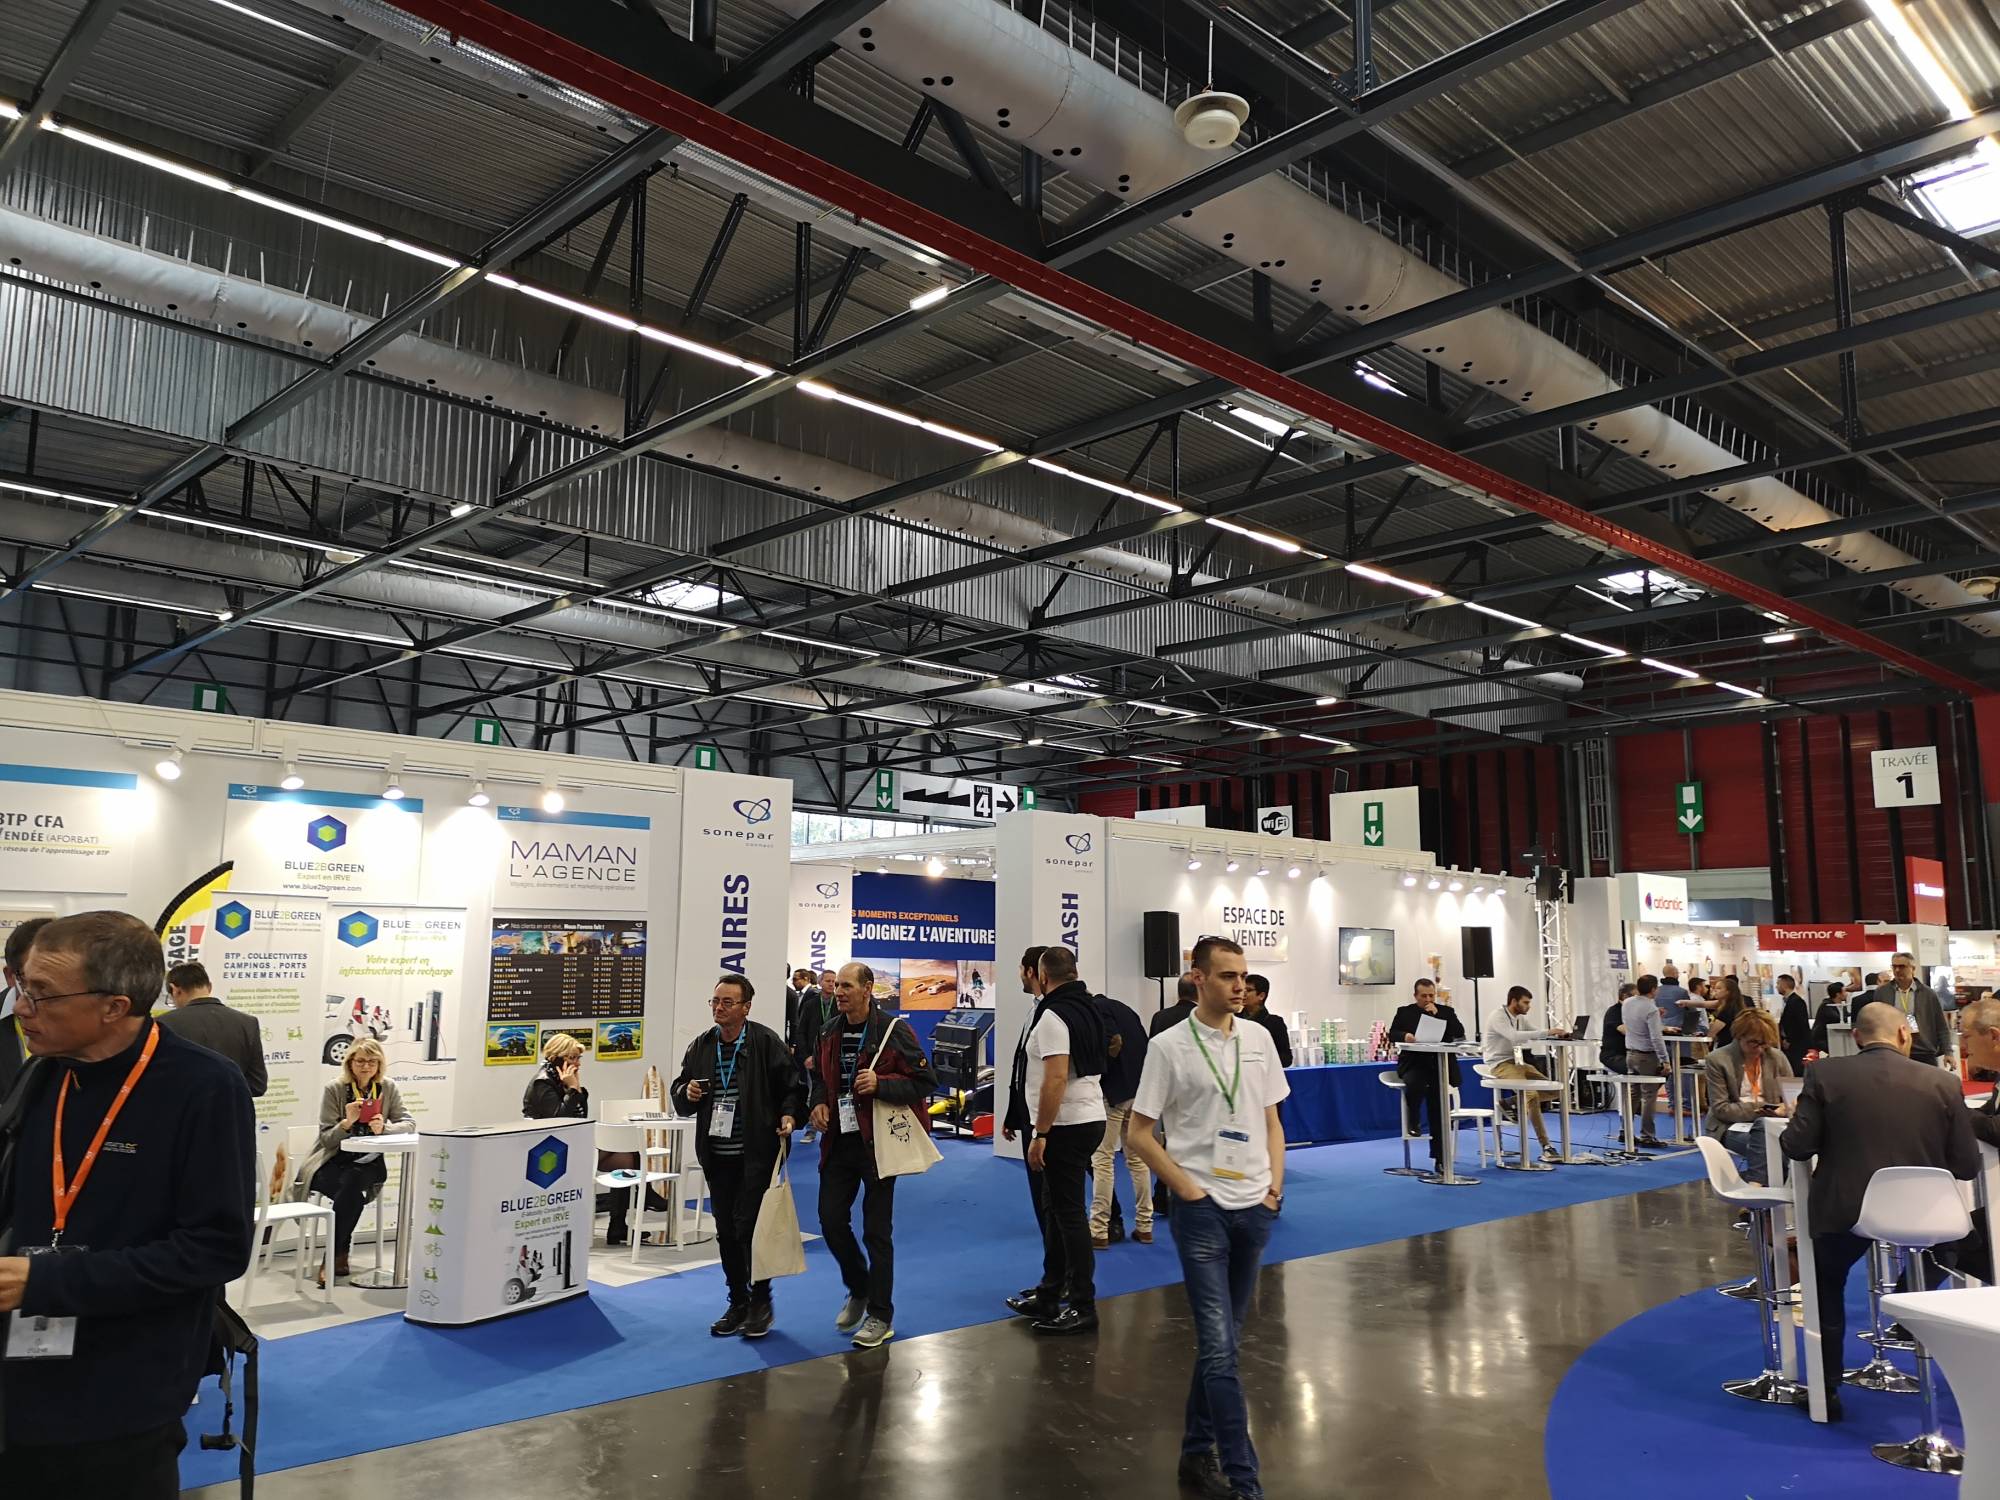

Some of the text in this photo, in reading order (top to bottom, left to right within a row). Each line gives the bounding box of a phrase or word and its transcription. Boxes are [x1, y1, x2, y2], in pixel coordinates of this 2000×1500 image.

[1880, 752, 1929, 767] TRAVÉE
[976, 786, 989, 794] HALL
[1896, 772, 1914, 799] 1
[976, 794, 991, 817] 4
[34, 815, 64, 828] CFA
[46, 834, 99, 844] (AFORBAT)
[703, 828, 774, 840] sonepar
[511, 840, 637, 865] MAMAN
[285, 861, 364, 872] BLUE2BGREEN
[1046, 858, 1093, 868] sonepar
[297, 873, 321, 881] Expert
[510, 863, 636, 882] L'AGENCE
[282, 883, 362, 892] www.blue2bgreen.com
[1653, 896, 1684, 911] atlantic
[858, 910, 897, 920] MOMENTS
[899, 911, 959, 923] EXCEPTIONNELS
[1223, 906, 1285, 926] ESPACE DE
[919, 925, 996, 945] L'AVENTURE
[1232, 928, 1277, 947] VENTES
[1772, 928, 1832, 940] Thermor
[224, 952, 308, 960] BTP COLLECTIVITES
[366, 954, 430, 966] Votre expert en
[223, 971, 306, 979] EVENEMENTIEL
[339, 966, 453, 977] infrastructures de recharge
[271, 1051, 290, 1060] IRVE
[501, 1188, 582, 1213] BLUE2BGREEN
[514, 1218, 540, 1229] Expert
[553, 1211, 569, 1221] IRVE
